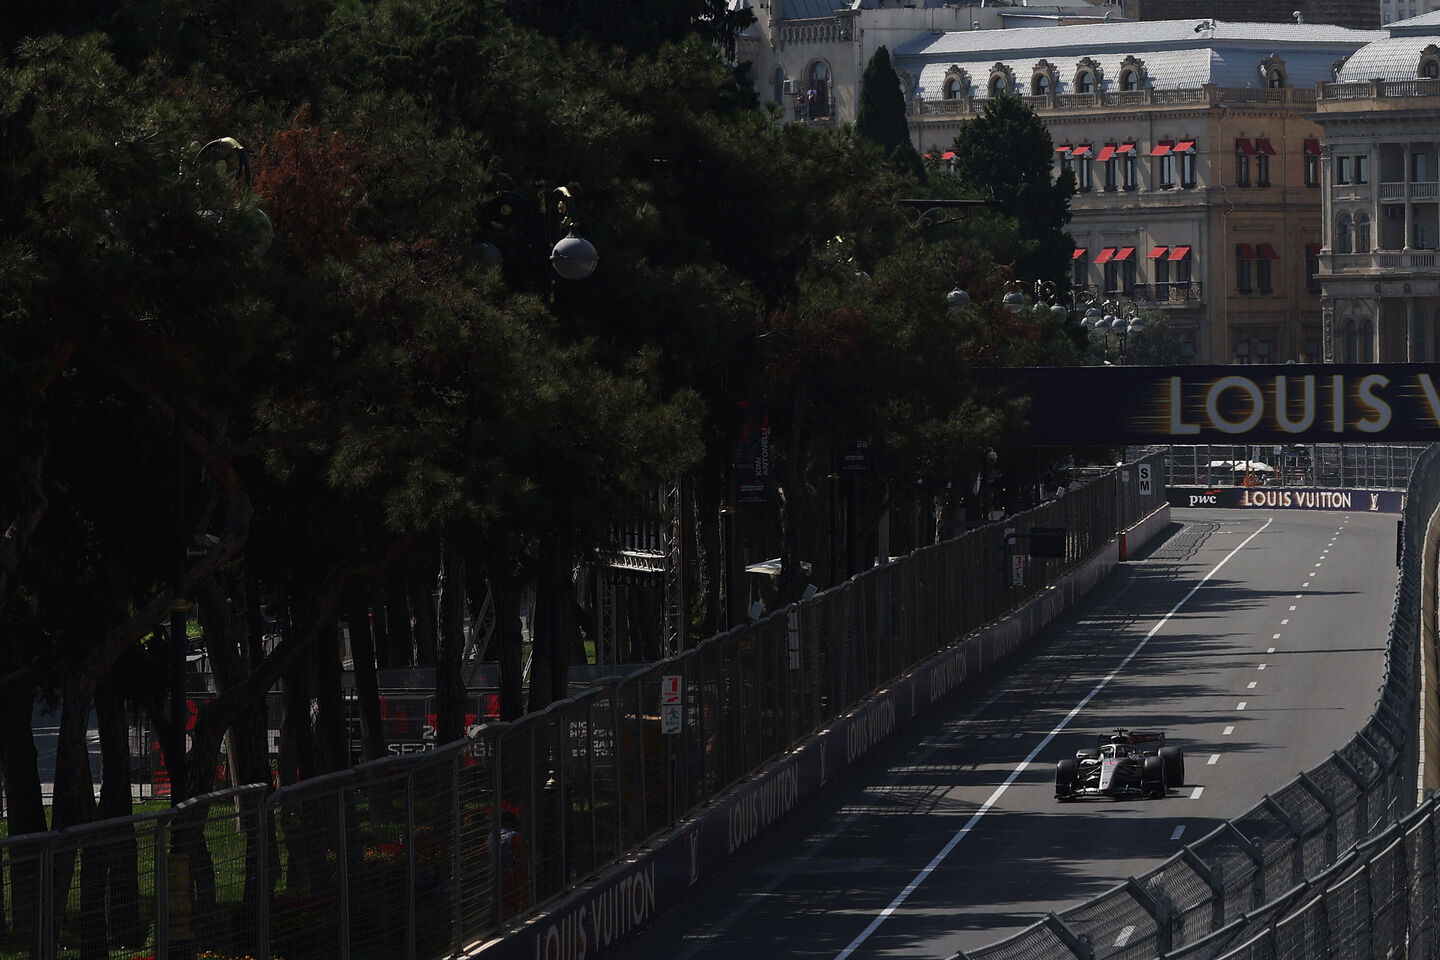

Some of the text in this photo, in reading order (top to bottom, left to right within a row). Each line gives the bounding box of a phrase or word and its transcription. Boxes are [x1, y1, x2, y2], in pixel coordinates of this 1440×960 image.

[1170, 374, 1392, 435] LOUIS
[1189, 495, 1217, 507] pwc
[1244, 490, 1352, 508] LOUIS VUITTON
[729, 763, 798, 854] LOUIS VUITTON
[592, 861, 656, 953] VUITTON
